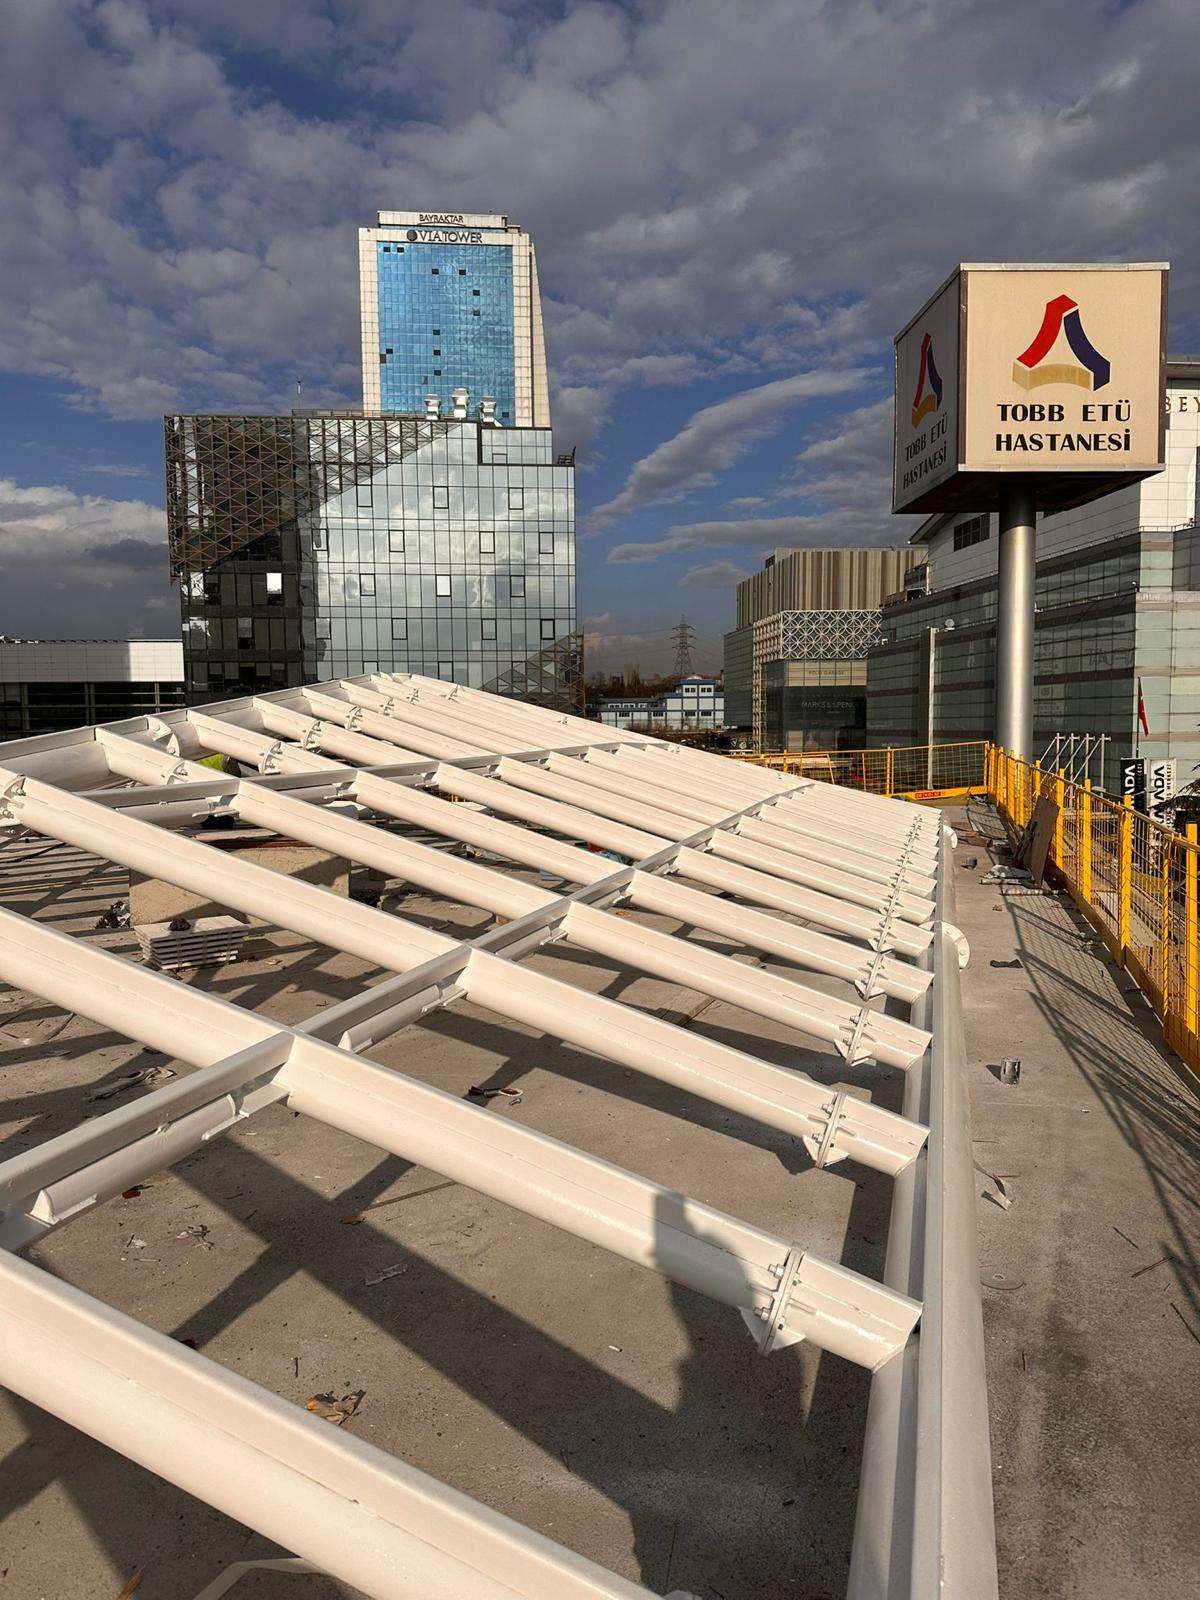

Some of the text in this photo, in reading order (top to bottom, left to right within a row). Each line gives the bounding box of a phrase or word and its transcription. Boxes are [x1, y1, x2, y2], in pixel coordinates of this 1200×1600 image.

[419, 214, 464, 223] BAYRAKTAR
[997, 399, 1130, 421] TOBB ETÜ
[905, 412, 947, 462] TOBB ETÜ
[995, 428, 1130, 451] HASTANESİ
[903, 440, 947, 489] HASTANESİ
